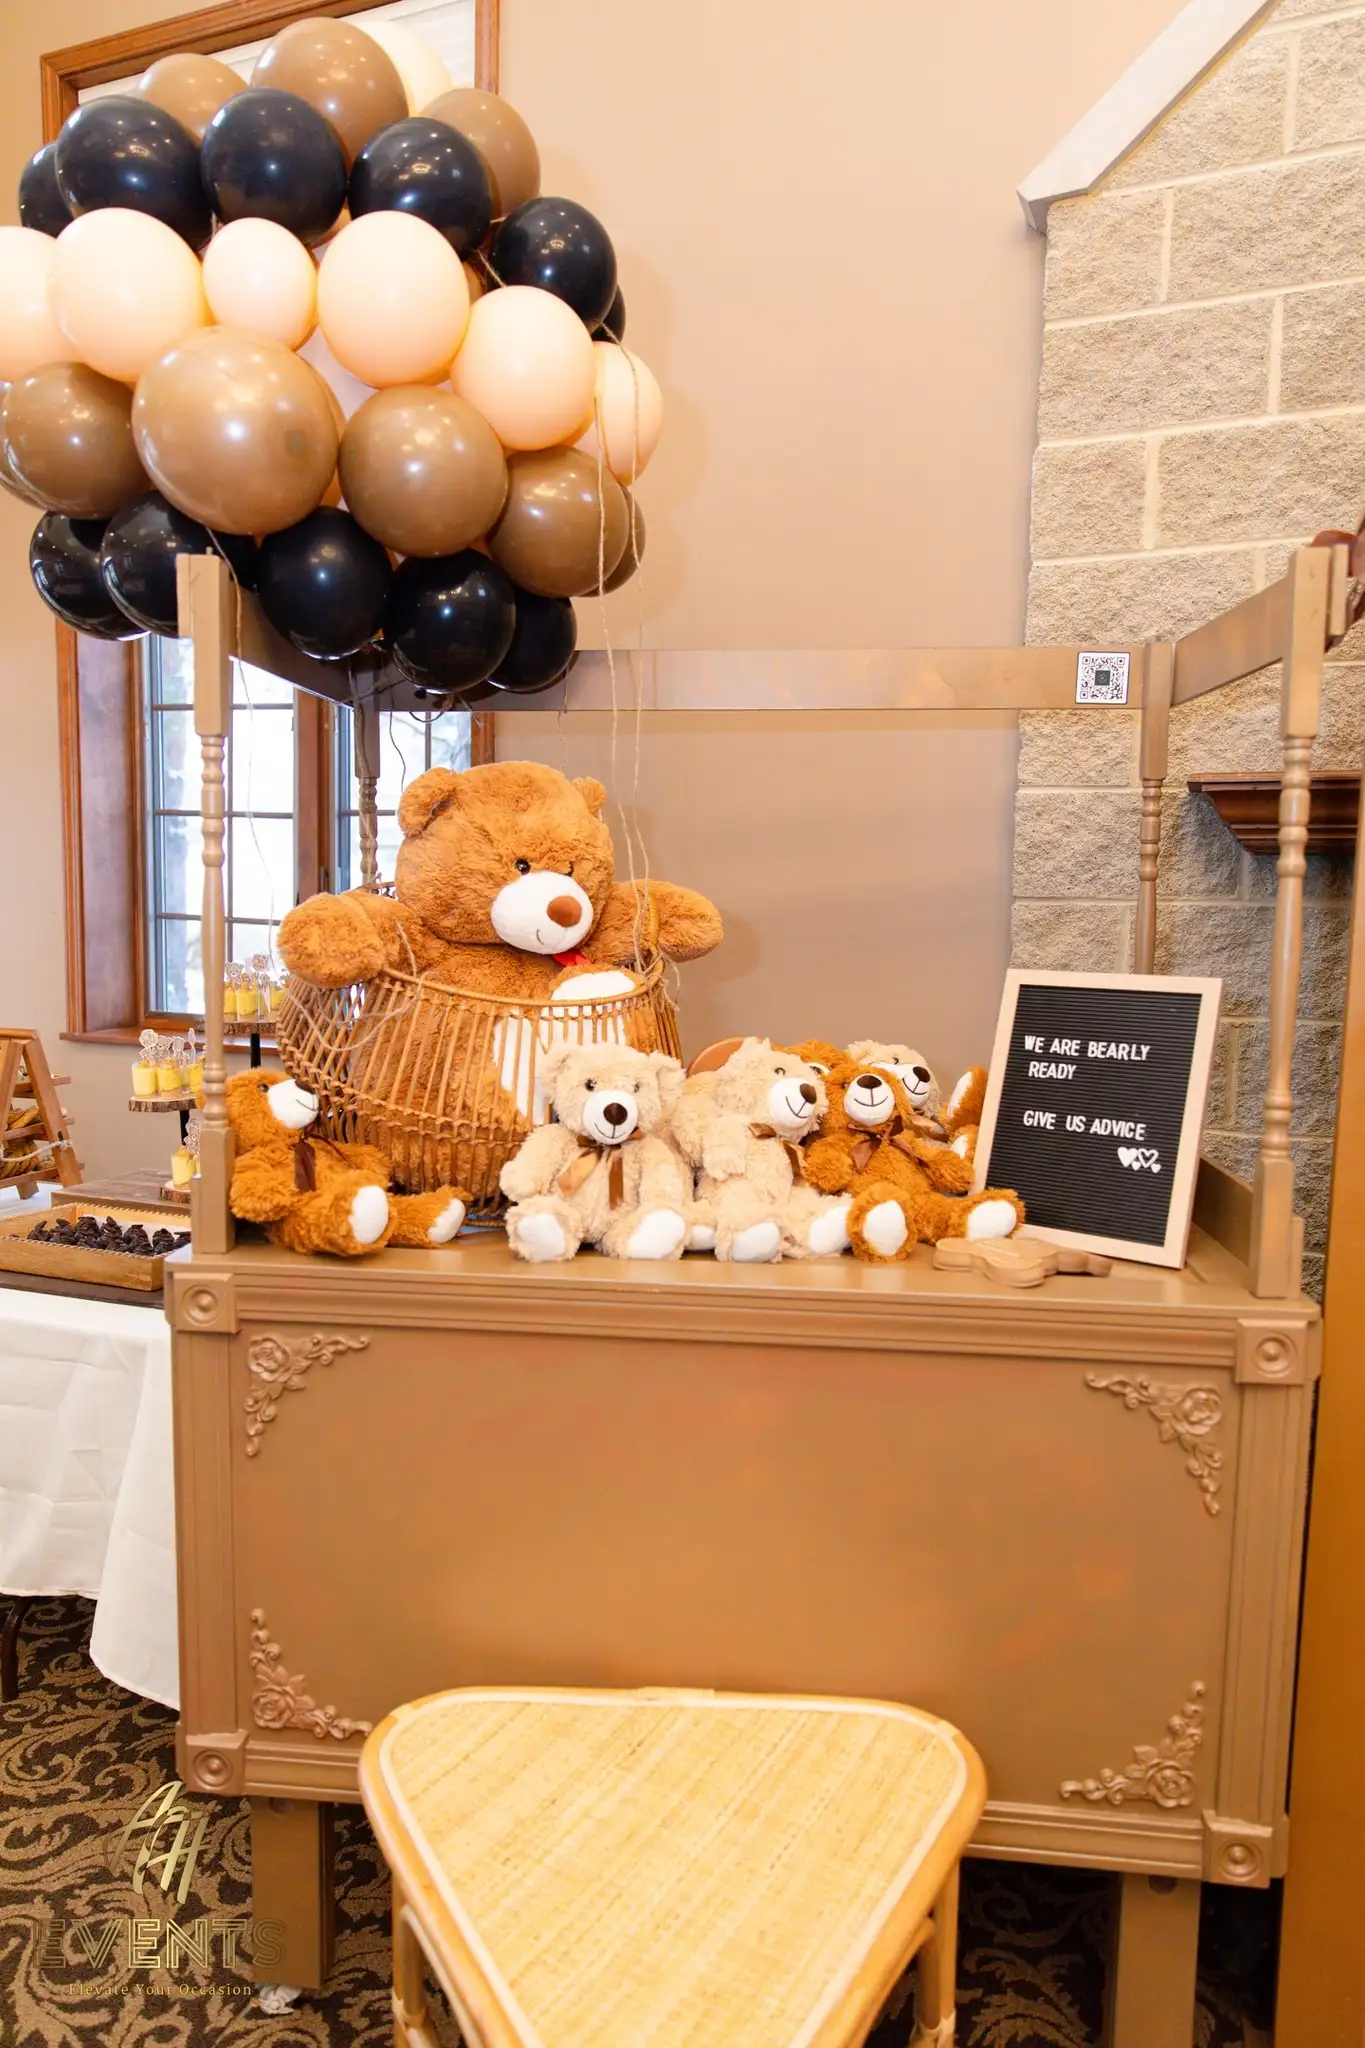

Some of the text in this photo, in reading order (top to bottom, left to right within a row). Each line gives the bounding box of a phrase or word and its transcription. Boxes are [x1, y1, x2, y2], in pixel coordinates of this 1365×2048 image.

[1024, 1035, 1151, 1061] WE ARE BEARLY
[1028, 1061, 1077, 1080] READY
[1023, 1110, 1146, 1141] GIVE US ADVICE
